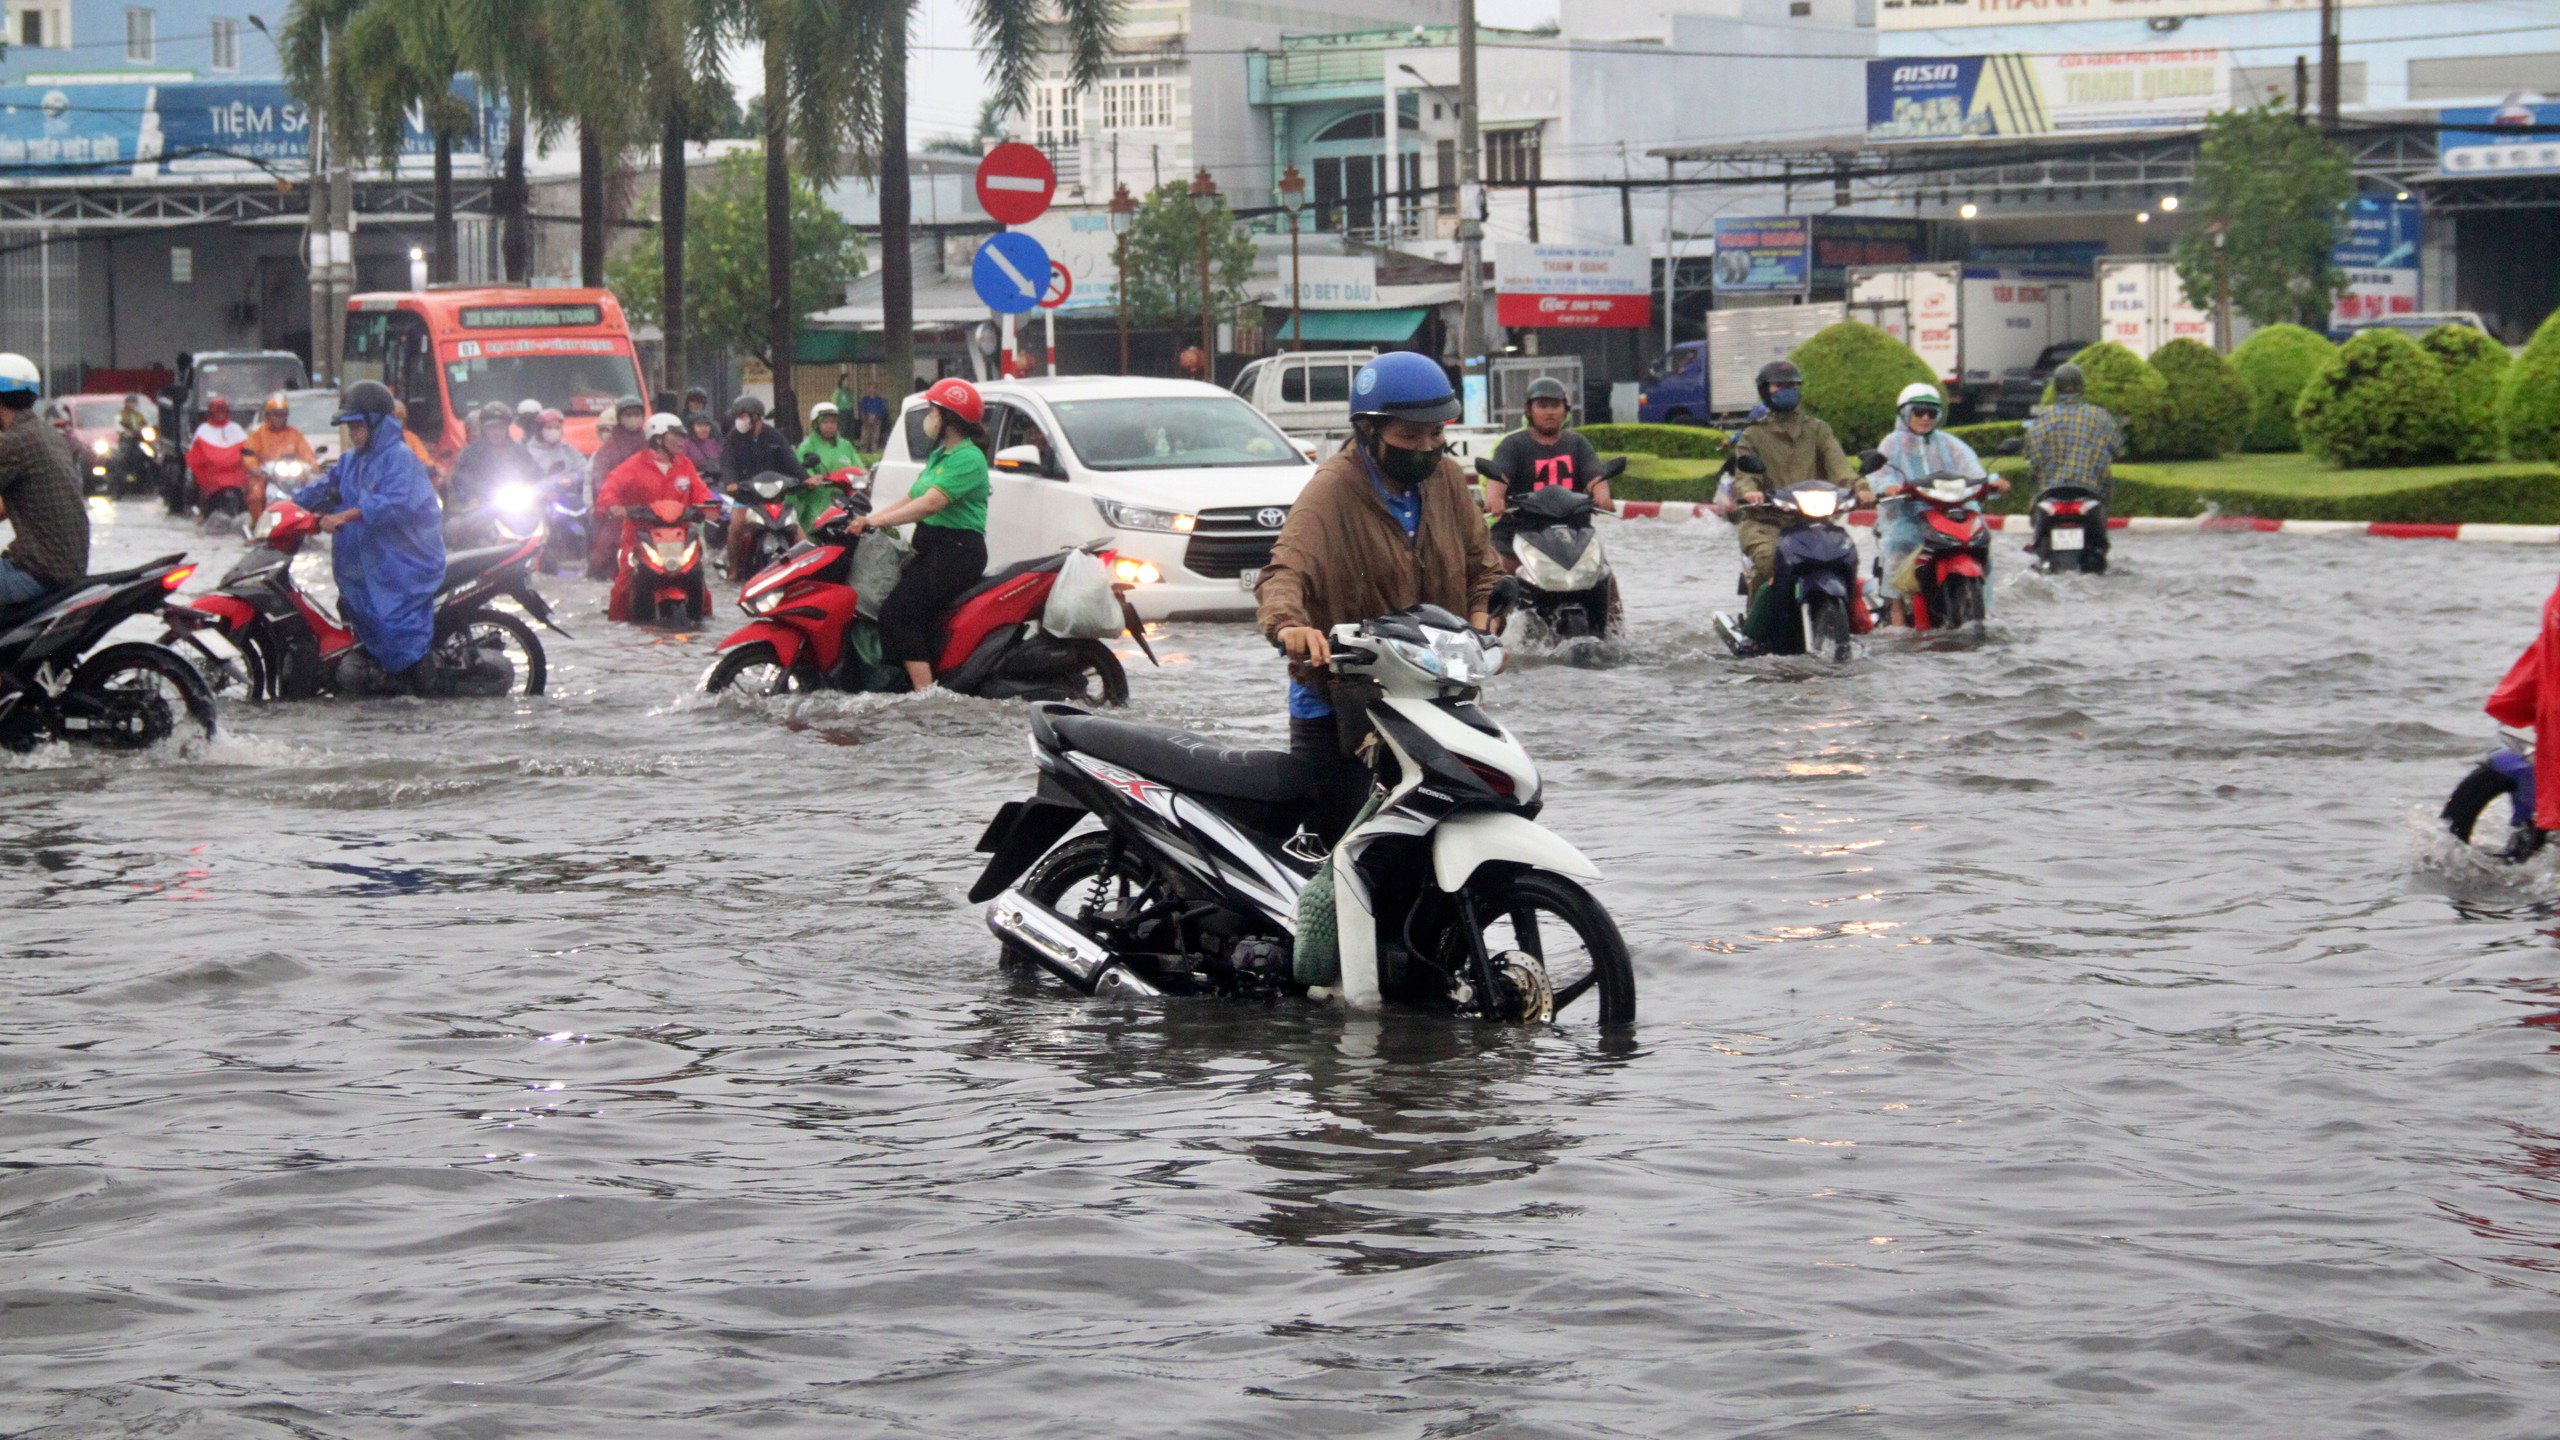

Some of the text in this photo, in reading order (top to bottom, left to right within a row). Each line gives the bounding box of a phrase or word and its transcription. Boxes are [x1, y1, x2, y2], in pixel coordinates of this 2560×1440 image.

[1892, 63, 1959, 83] AISIN
[210, 100, 273, 139] TIỆM
[1417, 786, 1455, 803] HONDA
